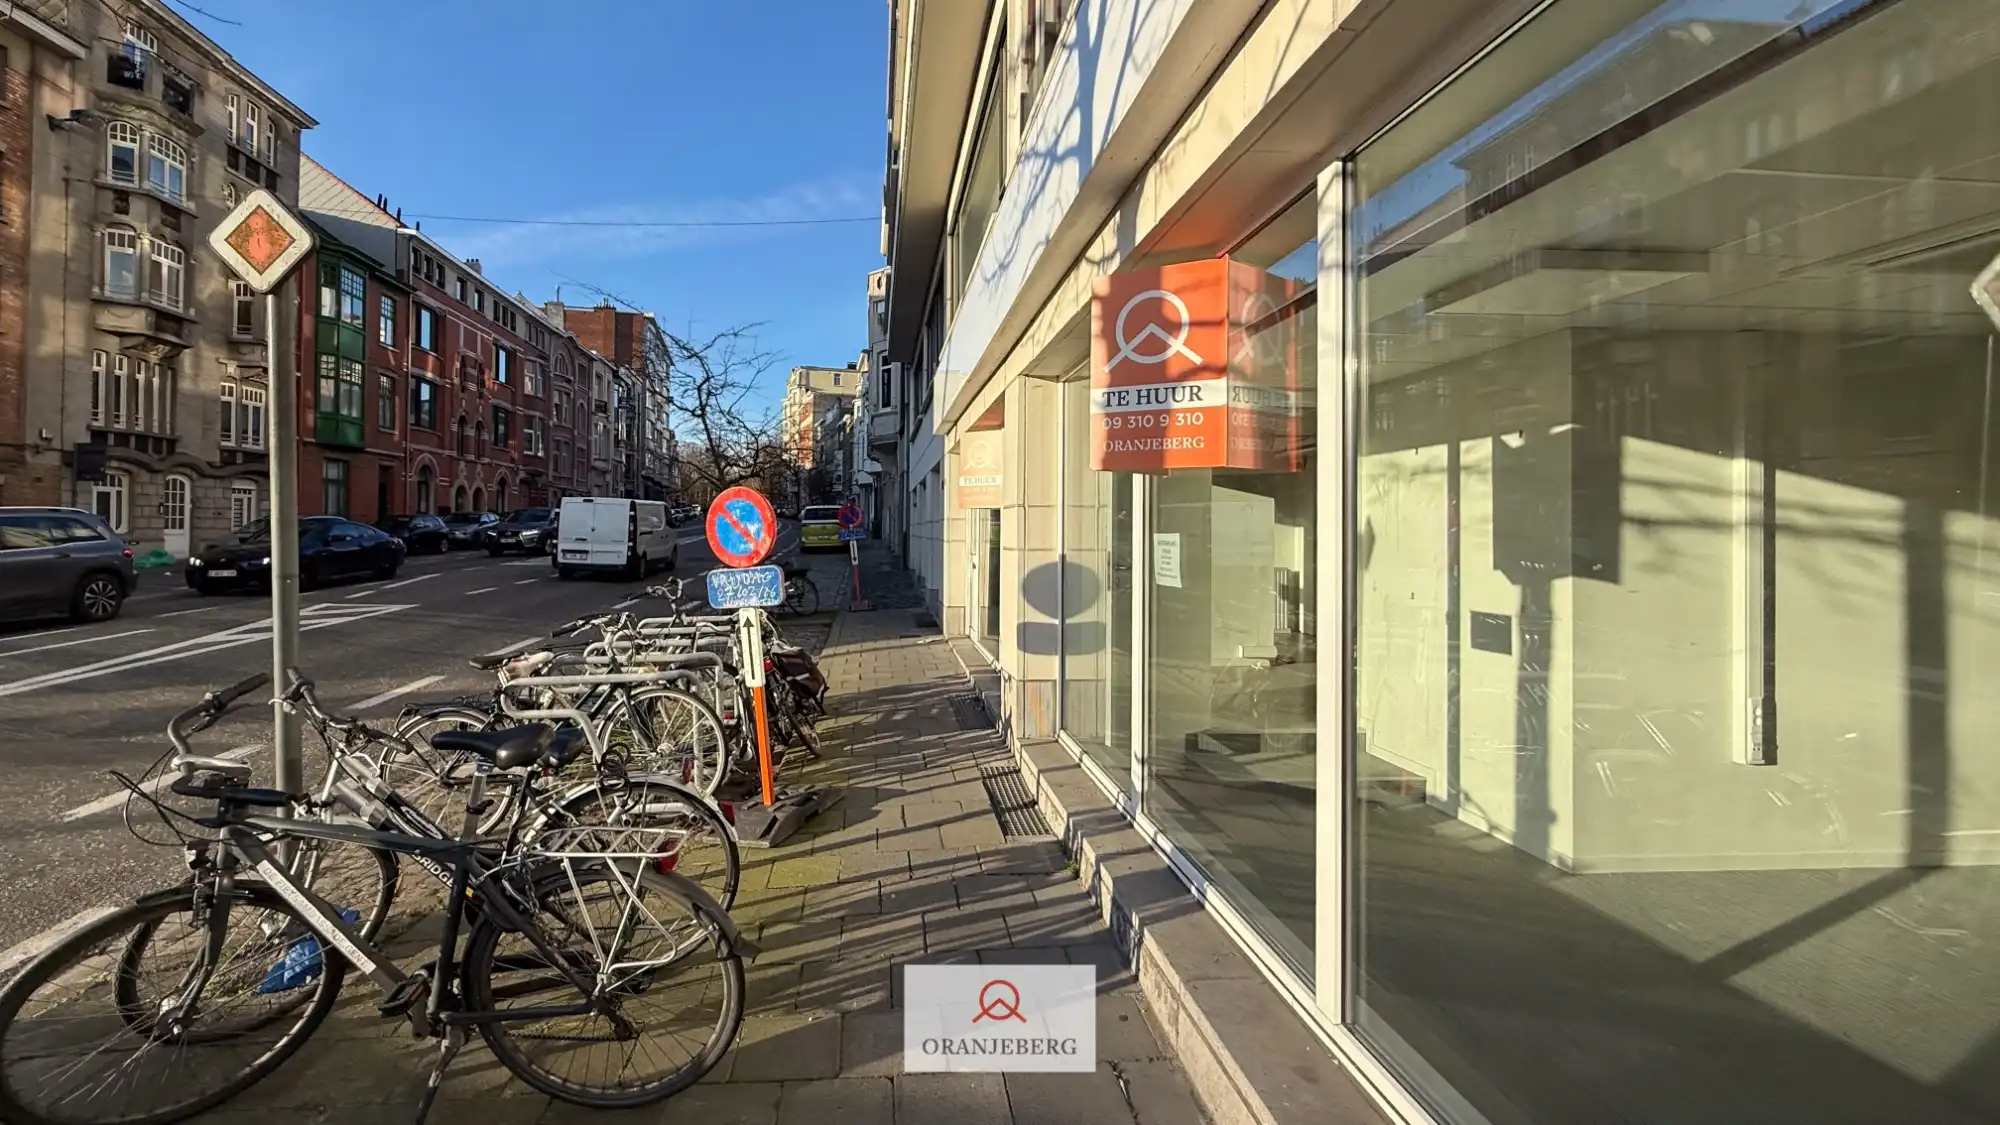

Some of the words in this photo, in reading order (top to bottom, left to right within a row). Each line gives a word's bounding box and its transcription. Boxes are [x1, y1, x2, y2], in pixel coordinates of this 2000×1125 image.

[1102, 390, 1129, 407] TE
[1136, 385, 1203, 405] HUUR
[1103, 416, 1121, 430] 09
[1127, 414, 1154, 428] 310
[1160, 414, 1169, 427] 9
[1175, 412, 1204, 426] 310
[1103, 436, 1204, 452] ORANJEBERG
